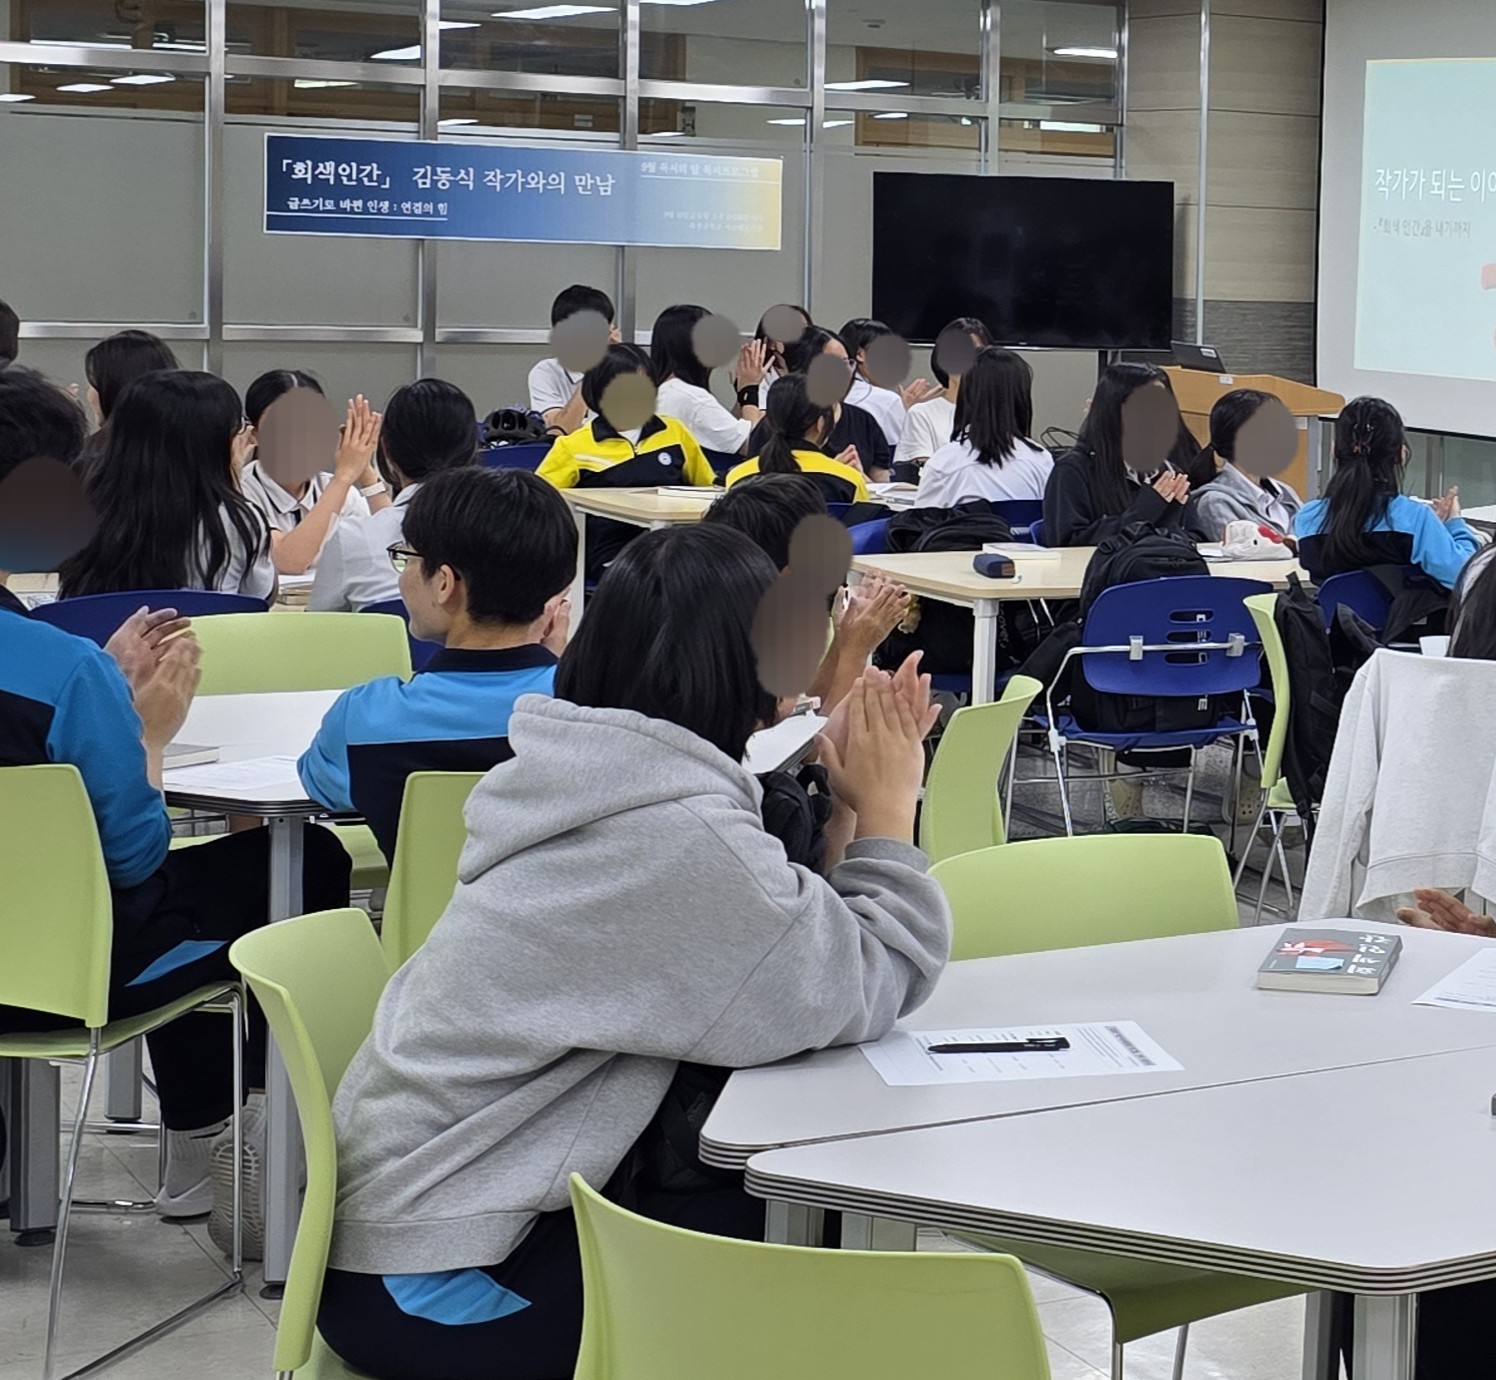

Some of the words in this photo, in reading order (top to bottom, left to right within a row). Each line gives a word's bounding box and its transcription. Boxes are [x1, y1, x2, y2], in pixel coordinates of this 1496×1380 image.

[282, 159, 391, 189] 「회색인간」
[411, 165, 475, 190] 김동식
[482, 168, 566, 195] 작가와의
[574, 173, 616, 195] 만남
[1375, 168, 1426, 201] 작가가
[1430, 168, 1465, 202] 되는
[287, 197, 336, 211] 글쓰기로
[366, 200, 389, 213] 인생
[401, 201, 433, 215] 연결의
[437, 202, 448, 216] 힘
